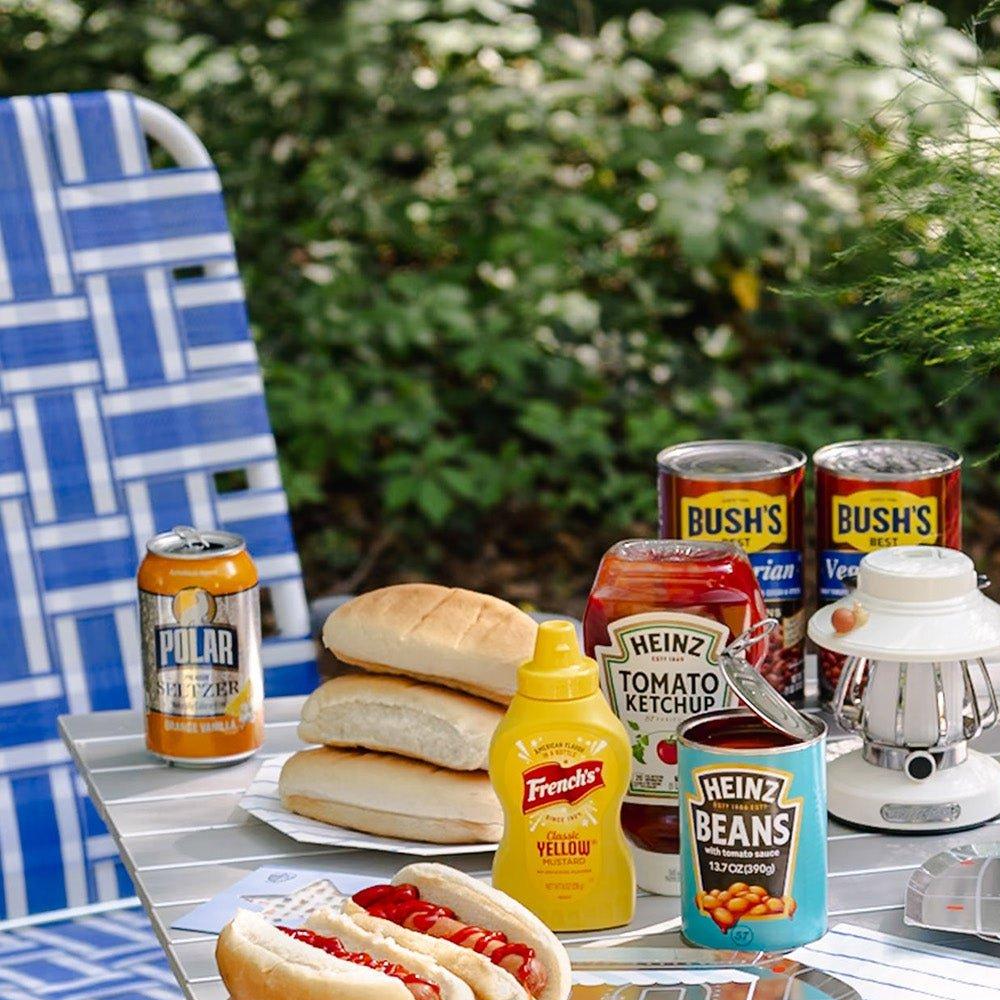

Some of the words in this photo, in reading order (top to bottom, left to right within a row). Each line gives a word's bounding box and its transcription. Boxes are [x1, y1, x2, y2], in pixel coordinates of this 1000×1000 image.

[688, 504, 782, 536] BUSH'S
[838, 504, 931, 536] BUSH'S
[870, 538, 898, 547] BEST
[160, 628, 234, 666] POLAR
[630, 633, 706, 657] HEINZ
[157, 681, 240, 698] SELTZER
[619, 671, 719, 695] TOMATO
[626, 695, 715, 714] KETCHUP
[526, 767, 596, 802] French's
[703, 776, 779, 803] HEINZ
[695, 809, 791, 848] BEANS
[537, 840, 591, 858] YELLOW
[704, 846, 721, 857] with
[722, 849, 753, 859] tomato
[754, 849, 780, 859] sauce
[543, 857, 586, 866] MUSTARD
